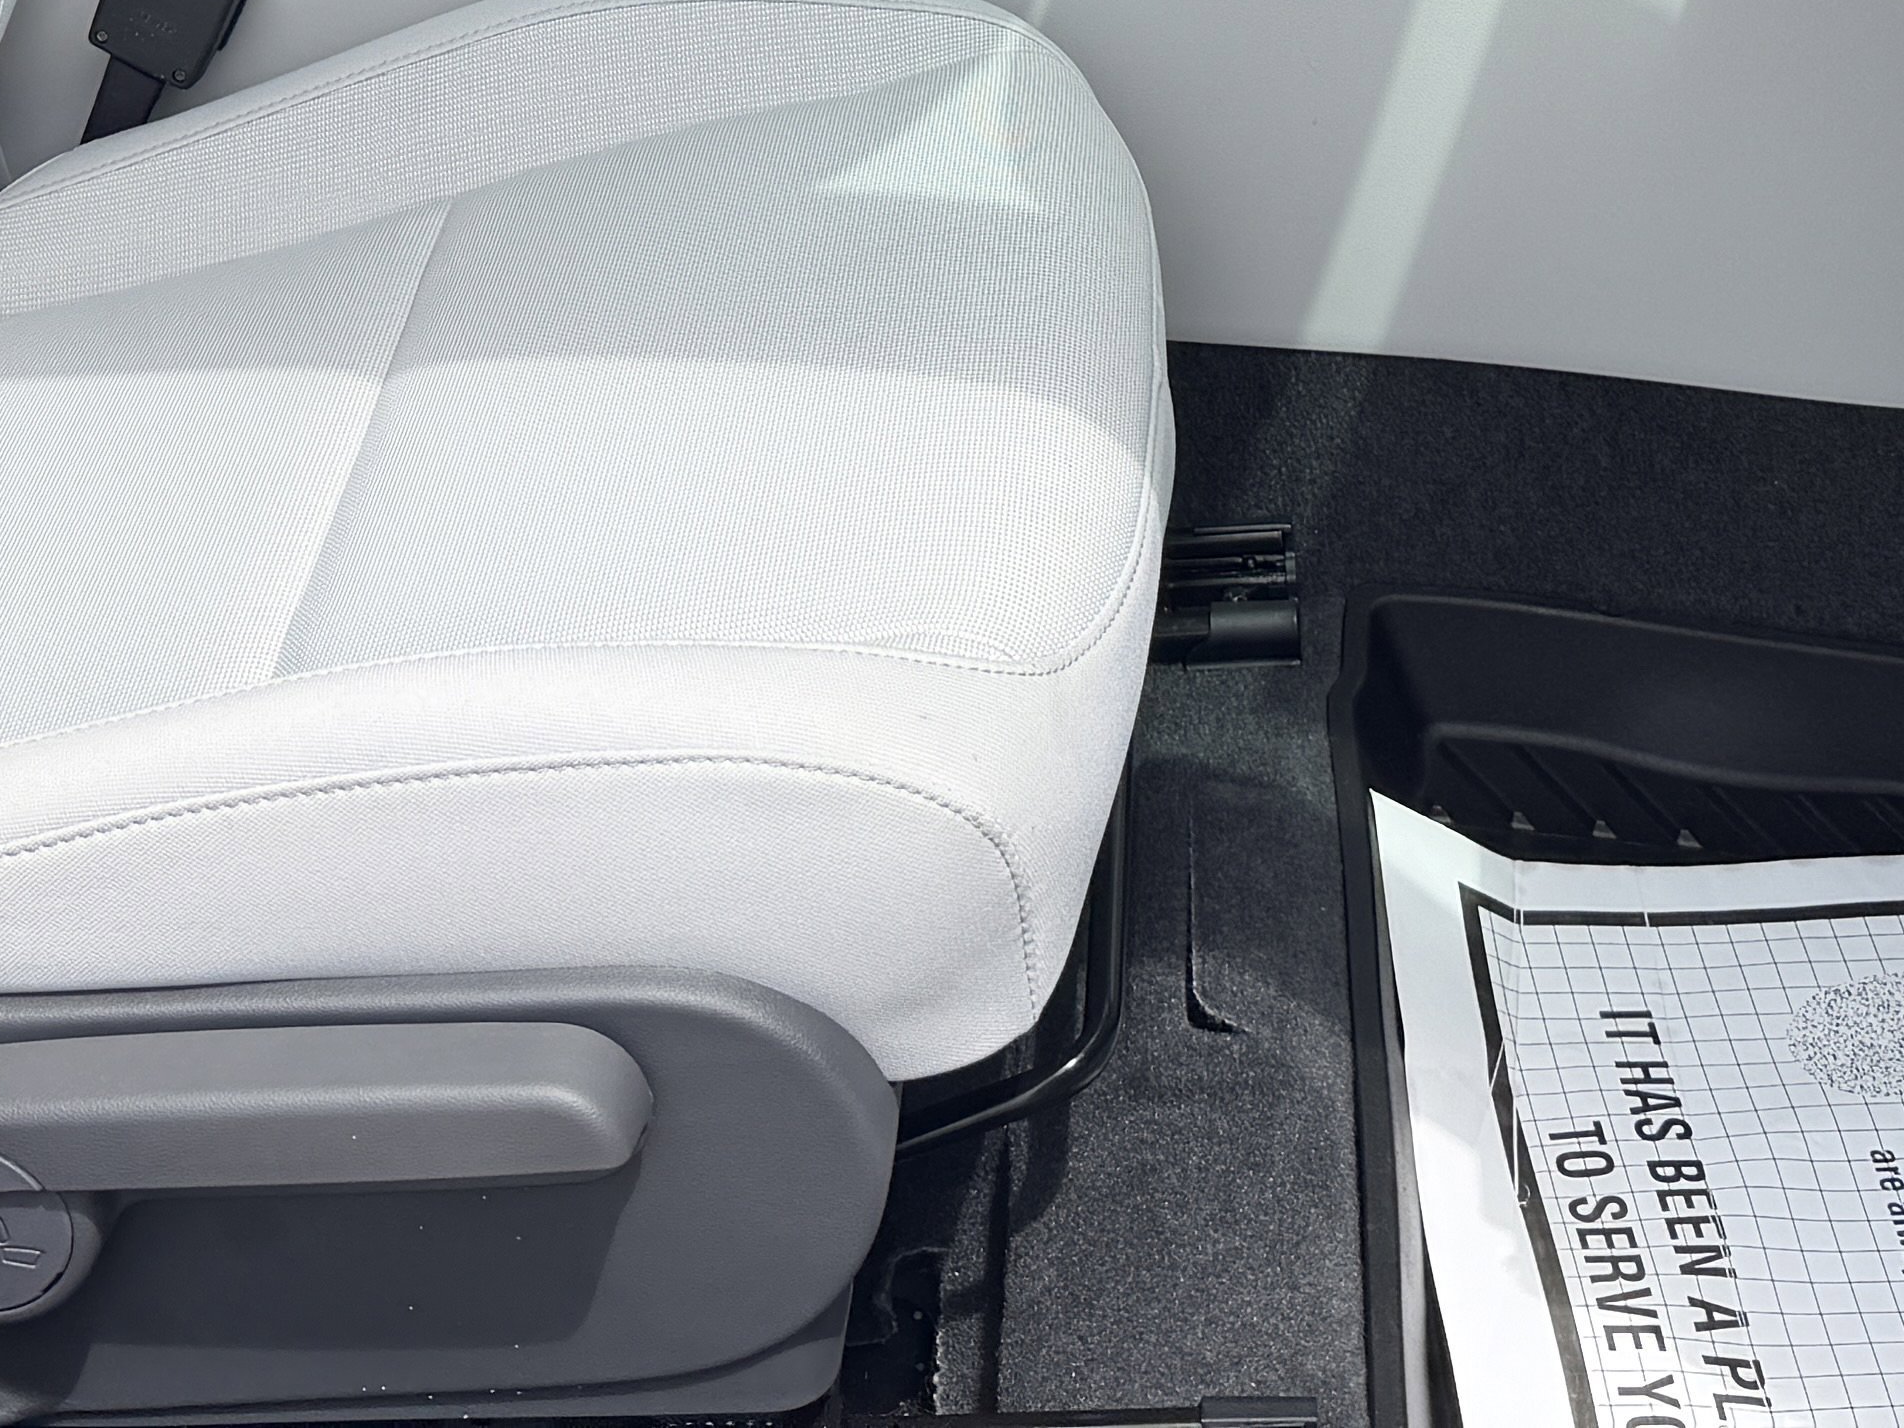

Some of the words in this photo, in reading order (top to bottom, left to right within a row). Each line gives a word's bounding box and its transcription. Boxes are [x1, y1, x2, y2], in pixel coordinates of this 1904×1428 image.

[1600, 1010, 1661, 1045] IT
[1615, 1061, 1693, 1141] HAS
[1549, 1121, 1614, 1178] TO
[1870, 1150, 1904, 1191] are
[1646, 1160, 1737, 1279] BEEN
[1568, 1196, 1666, 1351] SERVE
[1687, 1296, 1749, 1332] A
[1702, 1355, 1772, 1422] PL
